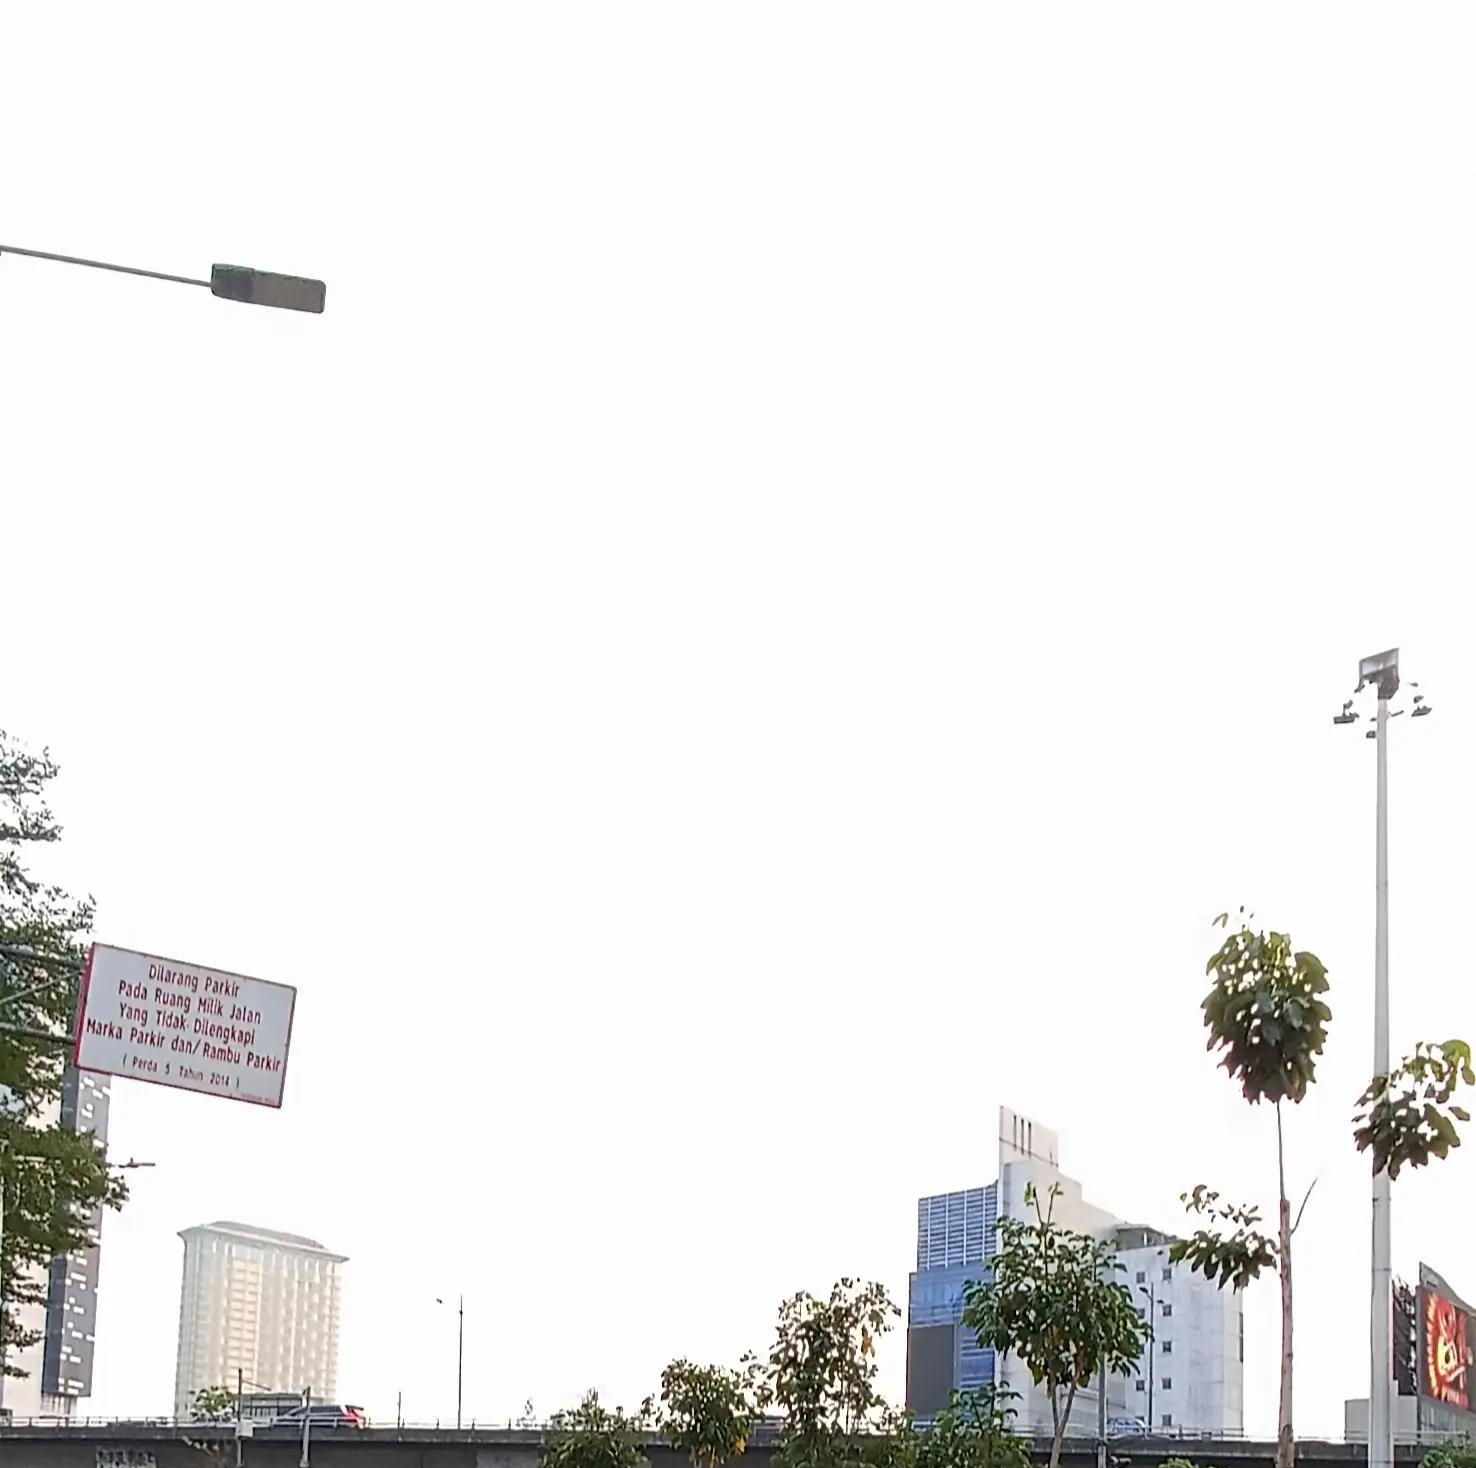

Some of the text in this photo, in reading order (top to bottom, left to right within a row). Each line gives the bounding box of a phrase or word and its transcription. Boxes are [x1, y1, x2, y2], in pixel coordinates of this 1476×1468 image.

[118, 980, 261, 1025] Pada Ruang Milik Jalan
[149, 964, 240, 998] Dilarang Parkir
[86, 1017, 122, 1040] Marka
[130, 1027, 165, 1050] Parkir
[246, 1051, 281, 1073] Parkir
[119, 1002, 256, 1048] Yang Tidak Dilengkapi
[132, 1056, 158, 1073] Perda
[179, 1065, 204, 1082] Tahun
[210, 1071, 229, 1087] 2014
